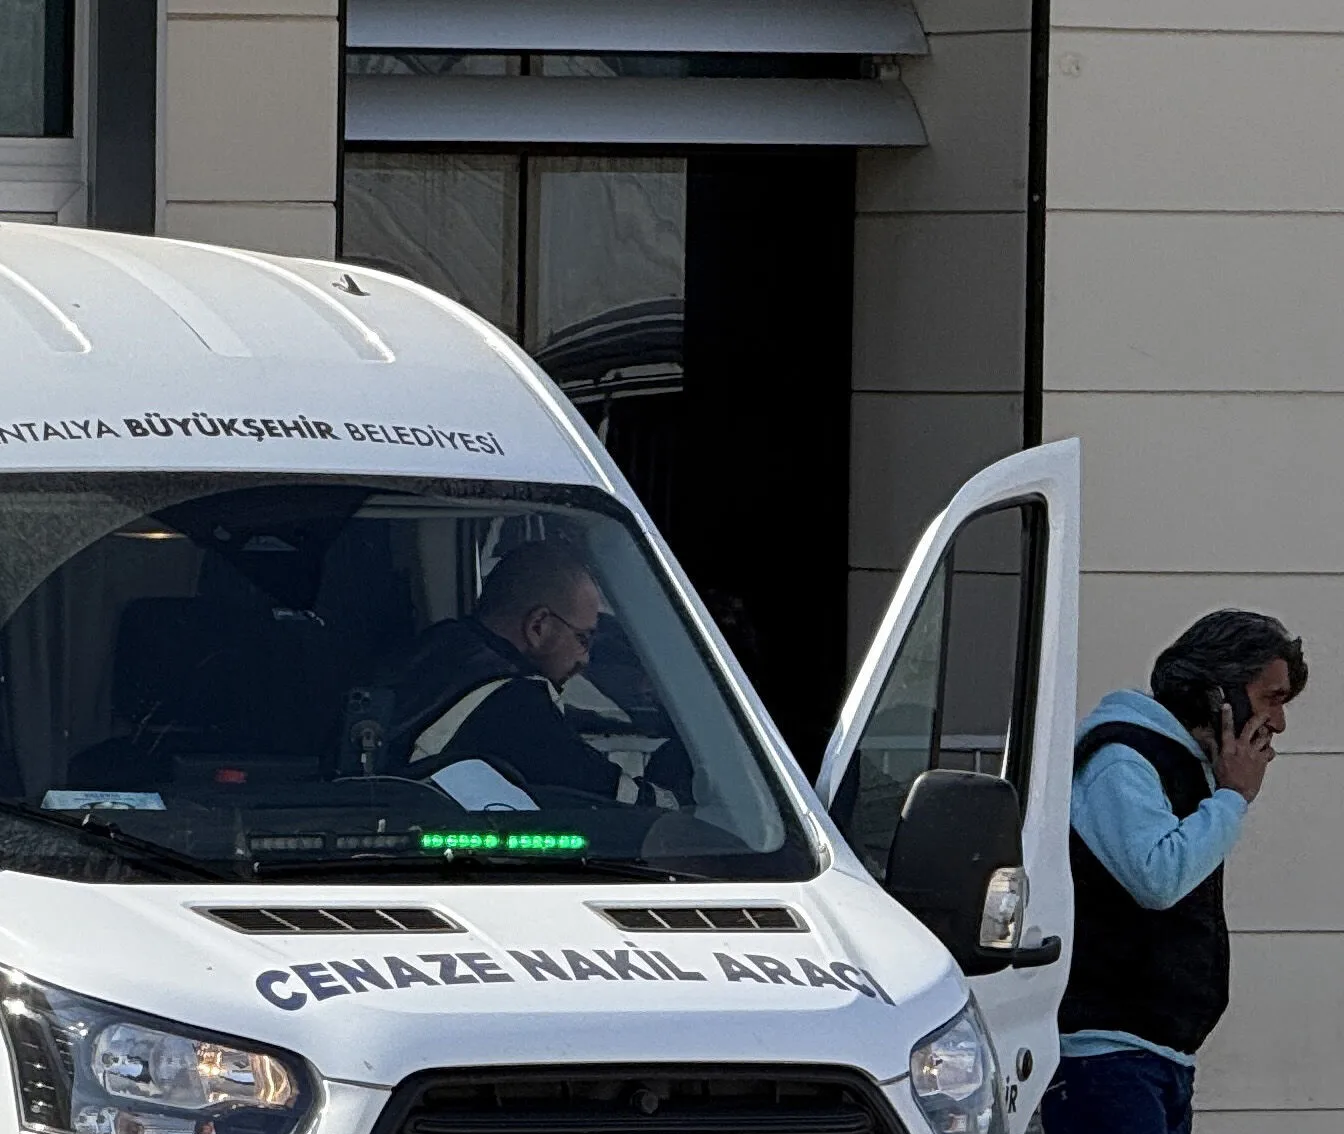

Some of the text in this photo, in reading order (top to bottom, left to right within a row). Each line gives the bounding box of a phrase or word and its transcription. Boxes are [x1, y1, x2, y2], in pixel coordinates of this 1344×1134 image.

[122, 412, 339, 441] BÜYÜKŞEHİR
[345, 422, 506, 457] BELEDİYESİ
[254, 940, 898, 1012] CENAZE NAKİL ARACI
